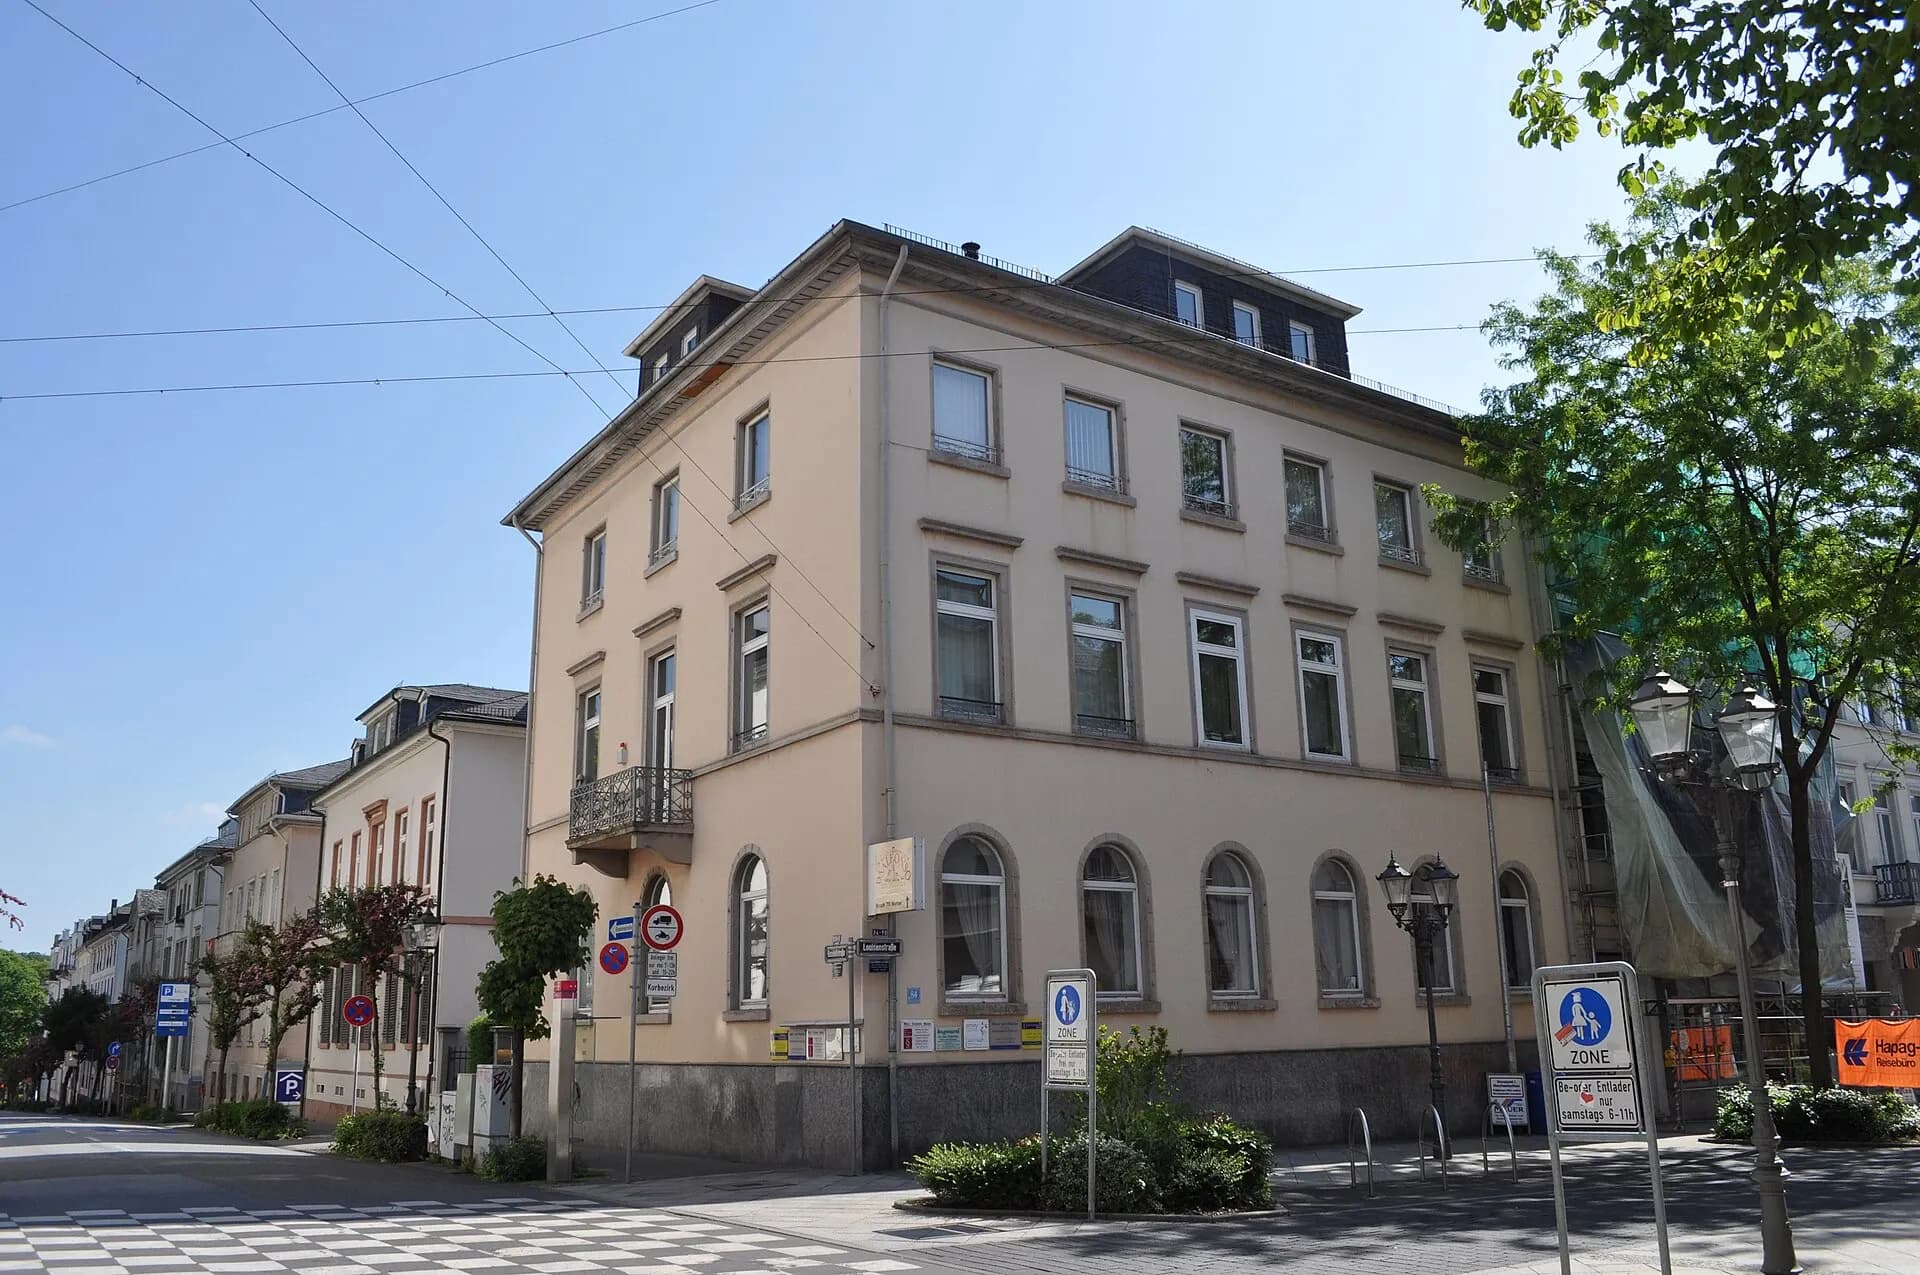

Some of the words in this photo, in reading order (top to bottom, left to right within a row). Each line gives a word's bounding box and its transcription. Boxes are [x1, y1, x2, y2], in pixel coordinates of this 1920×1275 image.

[862, 943, 897, 952] Louisenstraße
[647, 983, 675, 992] Kurbezirk
[1057, 1027, 1077, 1038] ZONE
[1570, 1049, 1611, 1065] ZONE
[1876, 1057, 1916, 1068] Reisebüro
[1596, 1080, 1631, 1093] Entlader
[1599, 1097, 1613, 1107] nur
[1561, 1108, 1604, 1123] samstags
[1608, 1108, 1635, 1121] 6-11h
